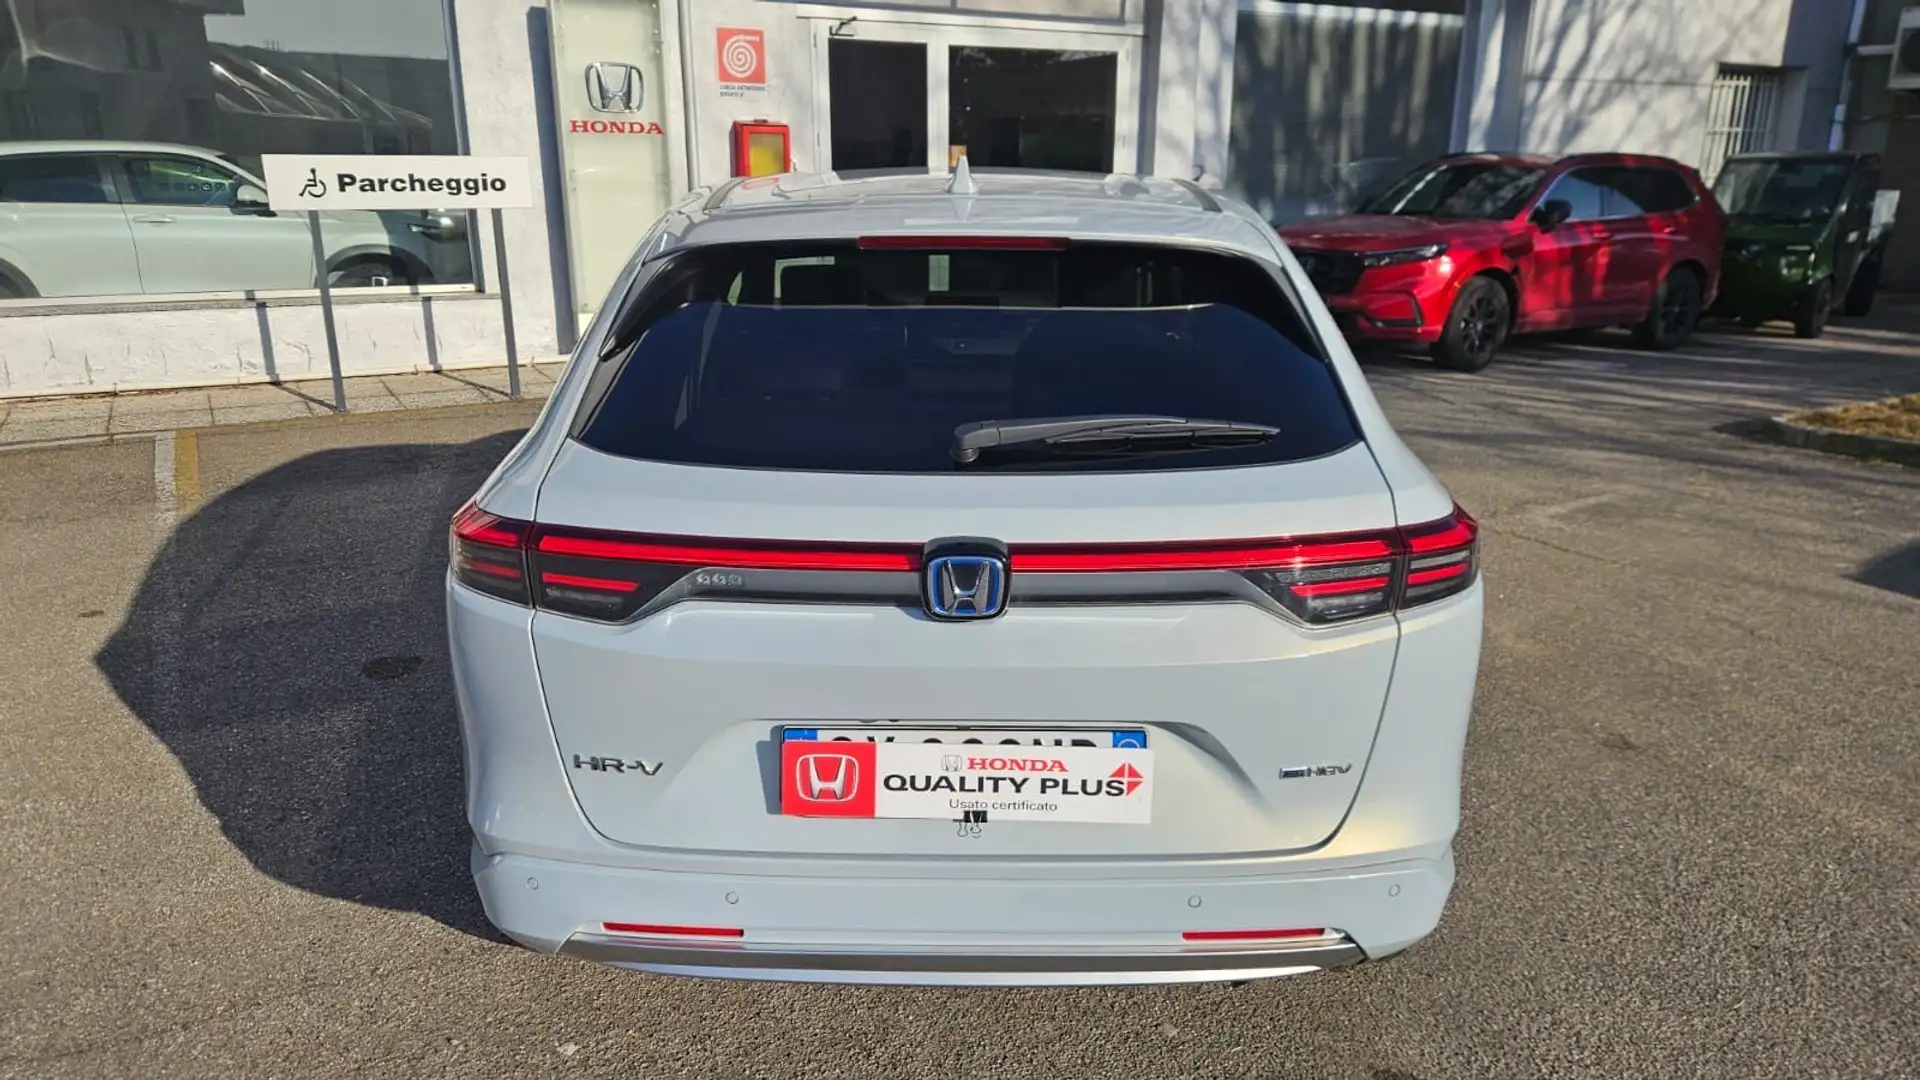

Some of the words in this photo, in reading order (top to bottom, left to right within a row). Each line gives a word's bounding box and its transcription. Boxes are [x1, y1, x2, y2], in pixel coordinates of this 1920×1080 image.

[569, 120, 664, 135] HONDA
[336, 173, 506, 196] Parcheggio
[573, 754, 664, 776] HR-V
[967, 757, 1069, 773] HONDA
[883, 774, 1030, 793] QUALITY
[1040, 778, 1125, 797] PLUS
[949, 798, 988, 810] Usato
[992, 799, 1058, 811] certificato
